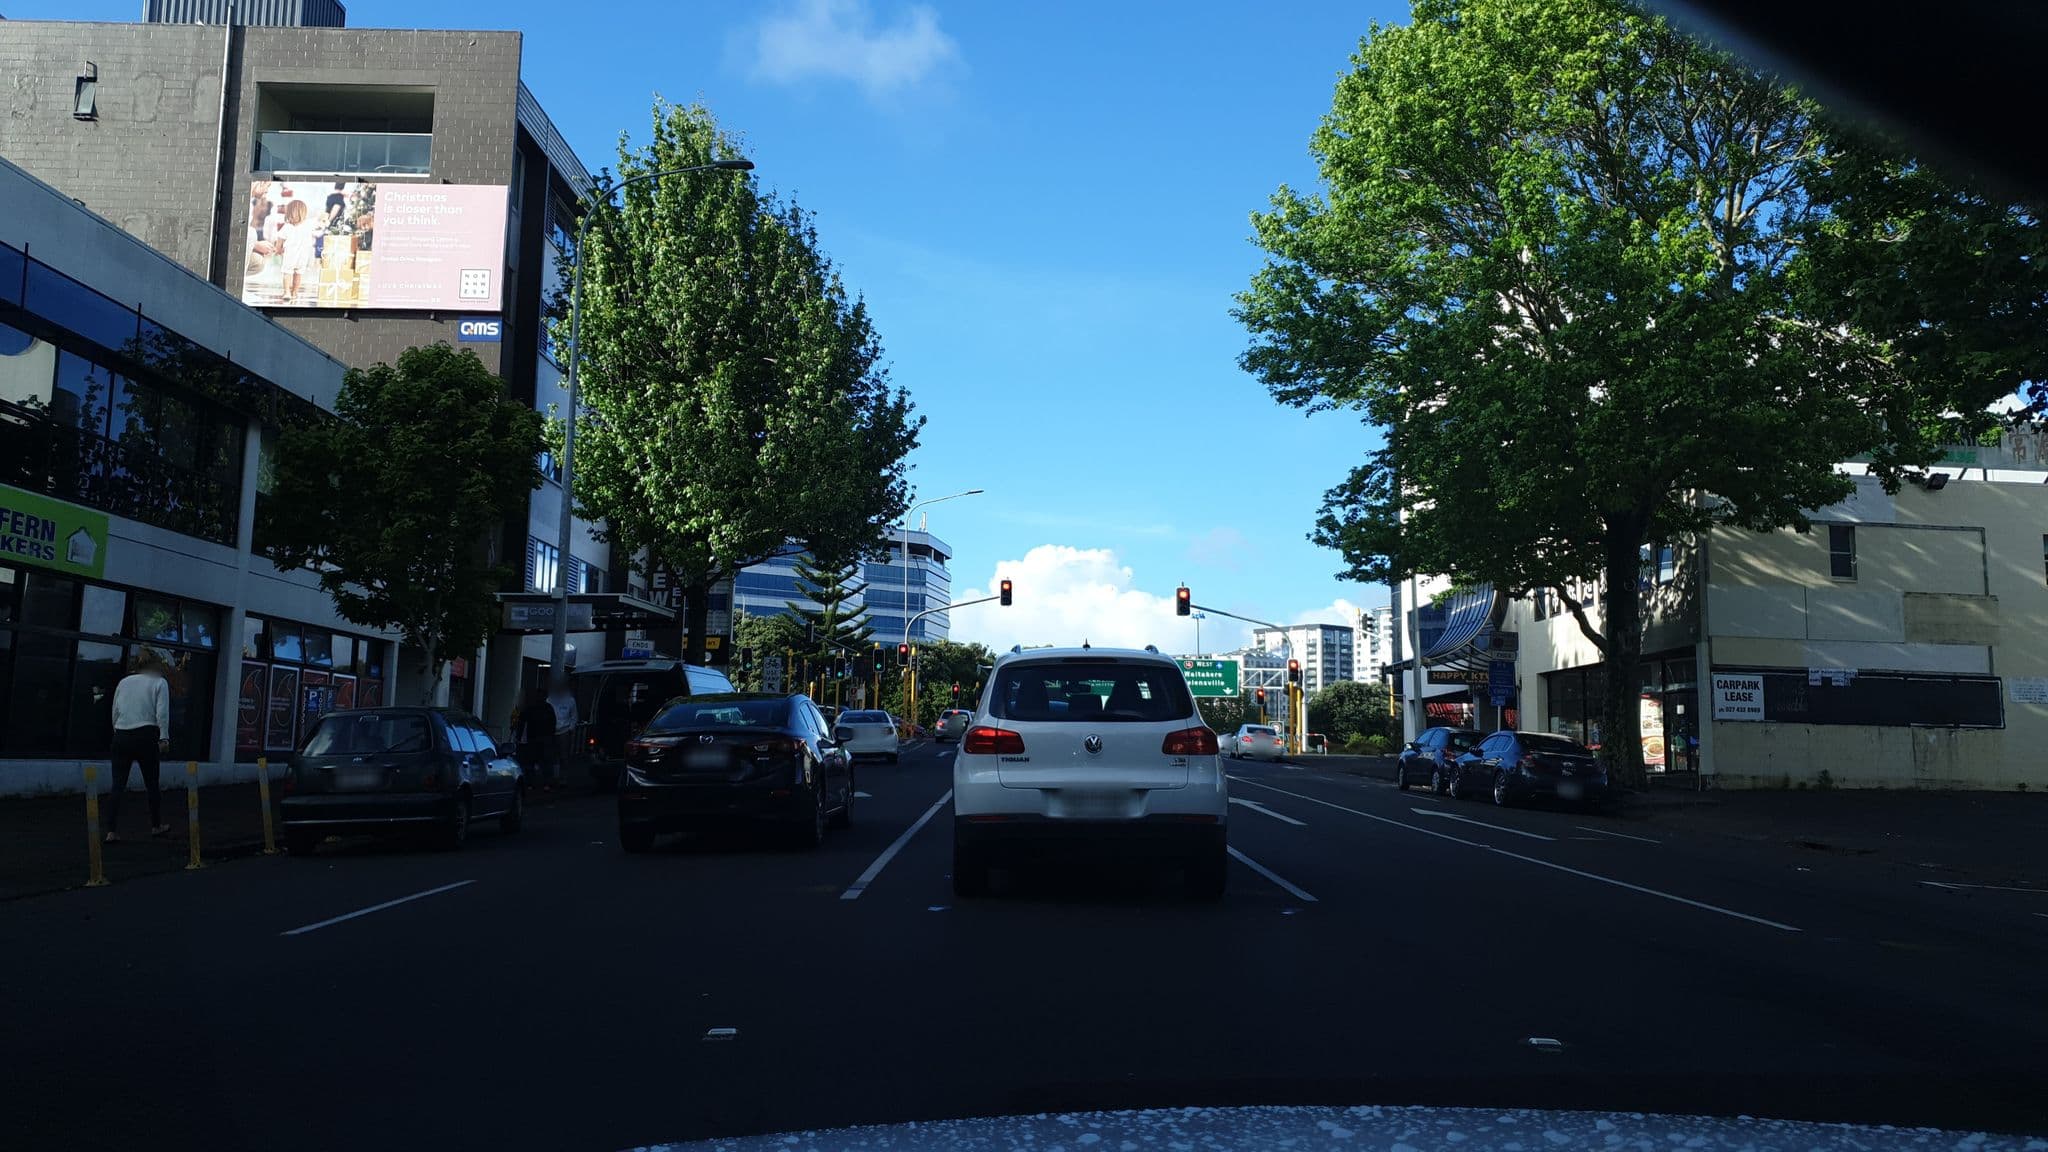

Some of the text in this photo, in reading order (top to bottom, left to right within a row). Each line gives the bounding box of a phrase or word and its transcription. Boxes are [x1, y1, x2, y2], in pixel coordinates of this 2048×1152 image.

[384, 191, 448, 202] Christmas
[384, 203, 464, 215] is closer than
[383, 215, 441, 226] you think.
[460, 321, 499, 336] QMS
[1432, 672, 1467, 680] HAPPY
[1716, 679, 1761, 691] CARPARK
[1724, 692, 1754, 702] LEASE
